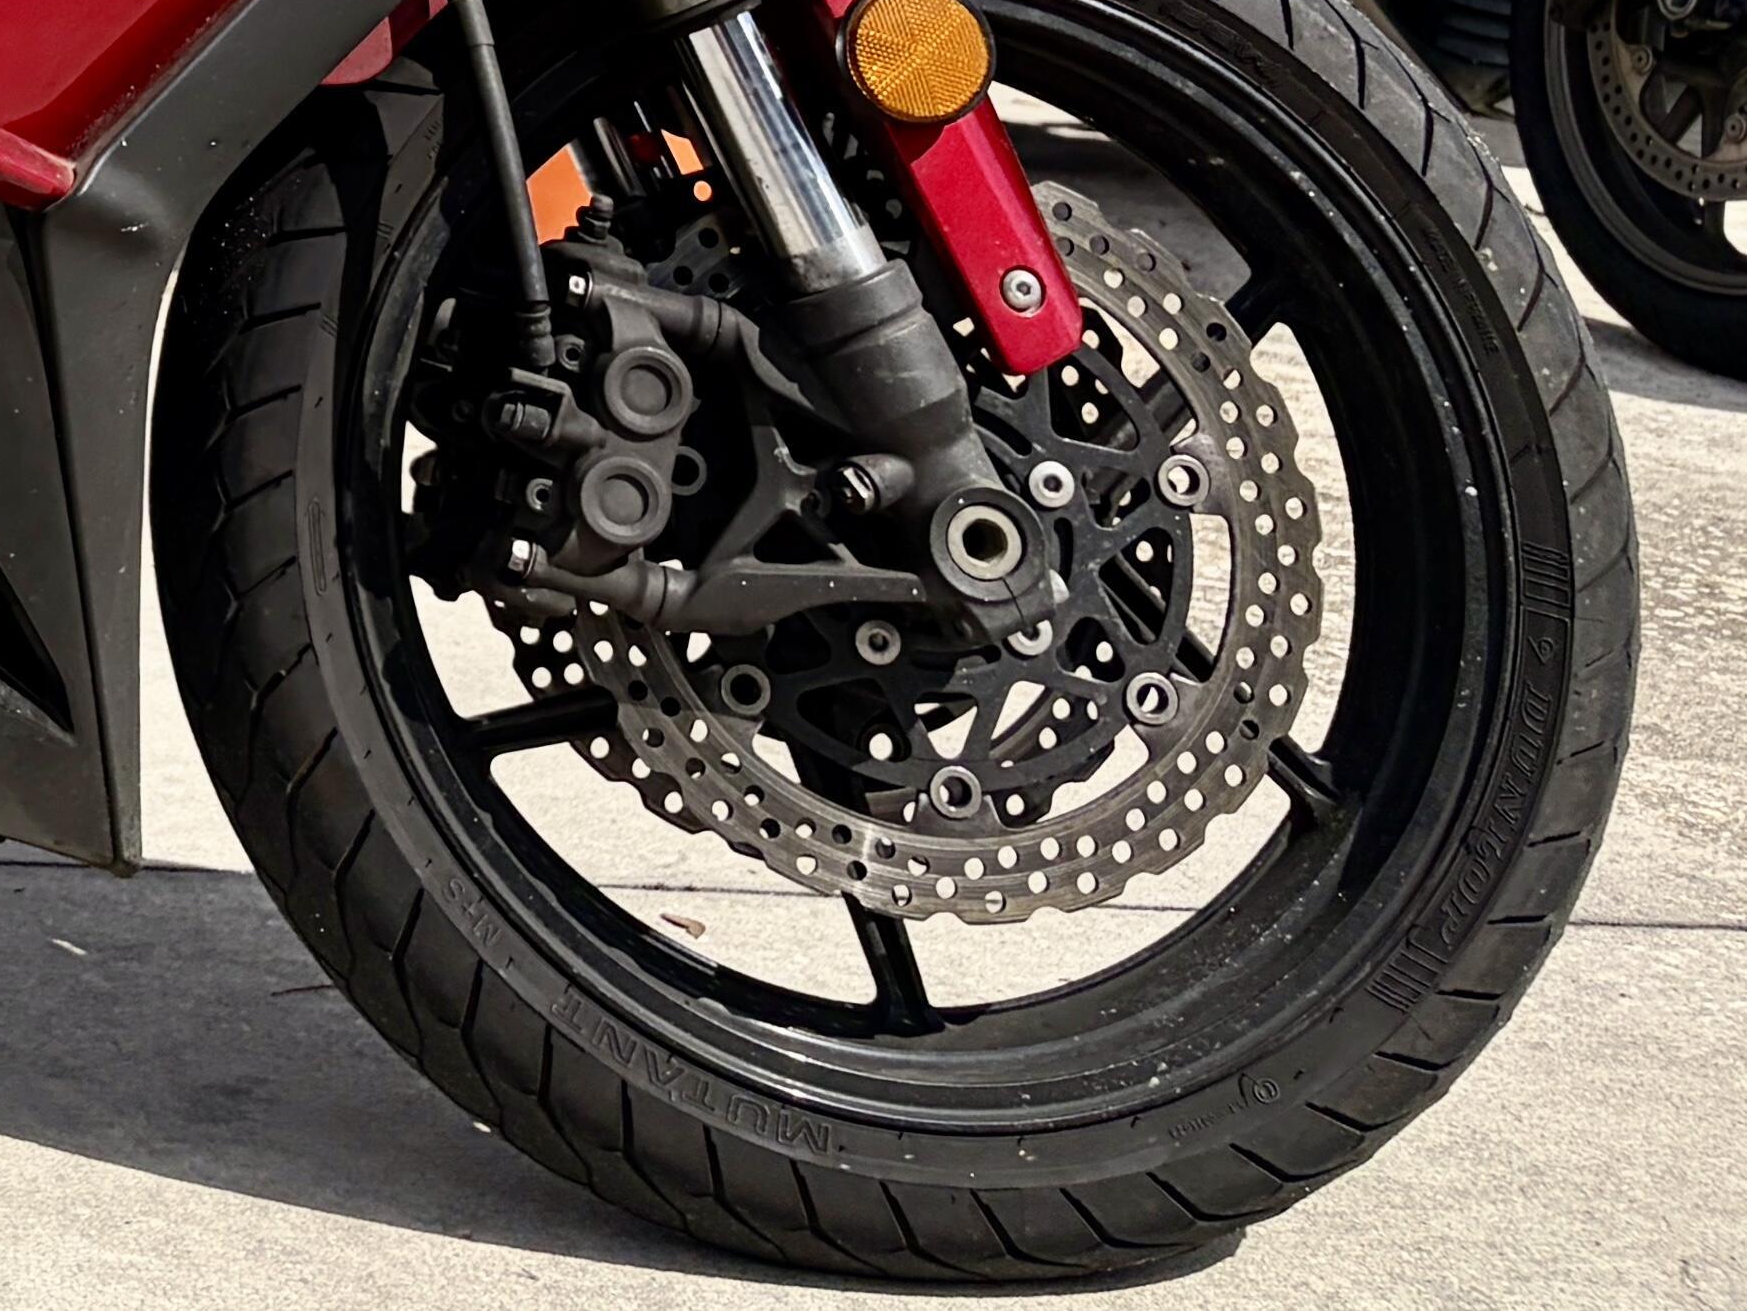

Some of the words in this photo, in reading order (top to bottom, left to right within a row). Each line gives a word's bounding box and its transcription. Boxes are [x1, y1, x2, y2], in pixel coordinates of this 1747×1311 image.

[1440, 681, 1553, 948] DUNLOP
[441, 879, 503, 950] M+S
[550, 985, 834, 1155] MUTANT
